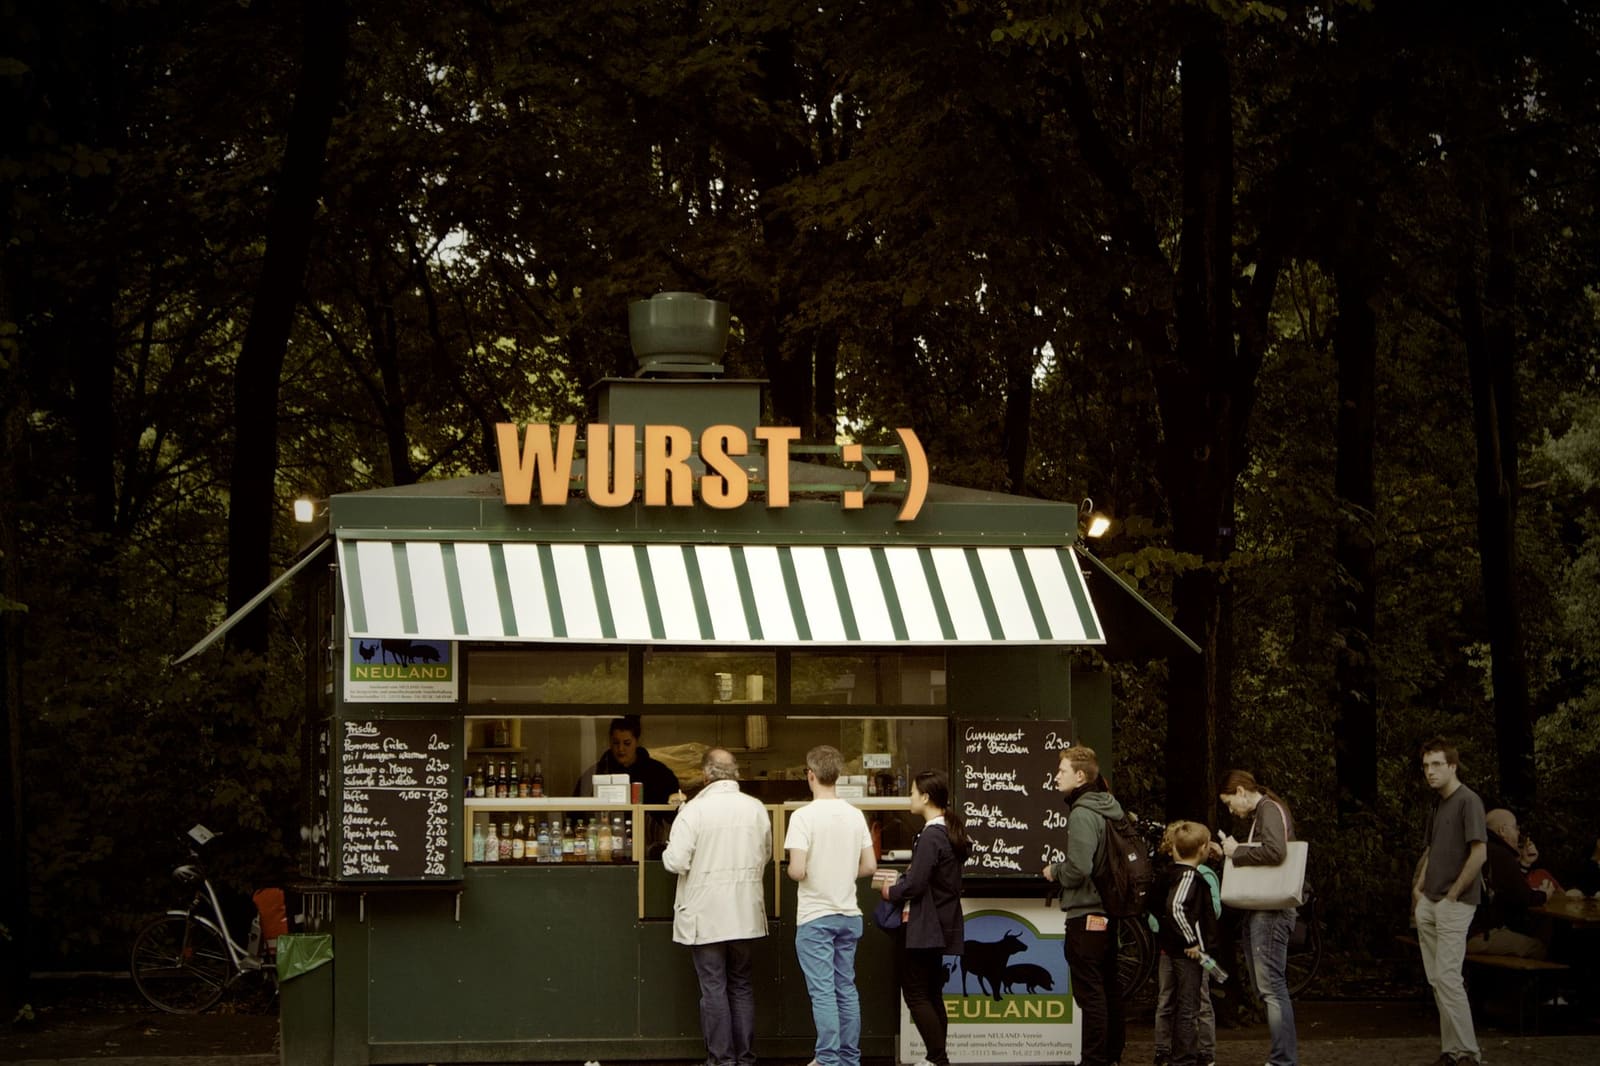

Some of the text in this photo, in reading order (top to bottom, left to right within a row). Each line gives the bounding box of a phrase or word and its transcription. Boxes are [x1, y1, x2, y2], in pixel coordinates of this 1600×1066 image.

[495, 423, 801, 509] WURST
[355, 666, 448, 679] NEULAND
[965, 726, 1025, 742] Currywurst
[344, 738, 380, 751] Pommes
[966, 742, 982, 753] mit
[343, 752, 359, 763] mit
[344, 763, 377, 778] Ketchup
[388, 763, 413, 776] Mayo
[964, 764, 1017, 781] Bratwurst
[425, 775, 448, 786] 0,50
[982, 780, 1029, 796] Brötchen
[427, 791, 449, 801] 1,50
[343, 802, 369, 814] Kakao
[343, 814, 373, 825] Wasser
[965, 817, 1029, 830] mit Brötchen
[945, 1000, 1065, 1018] EULAND
